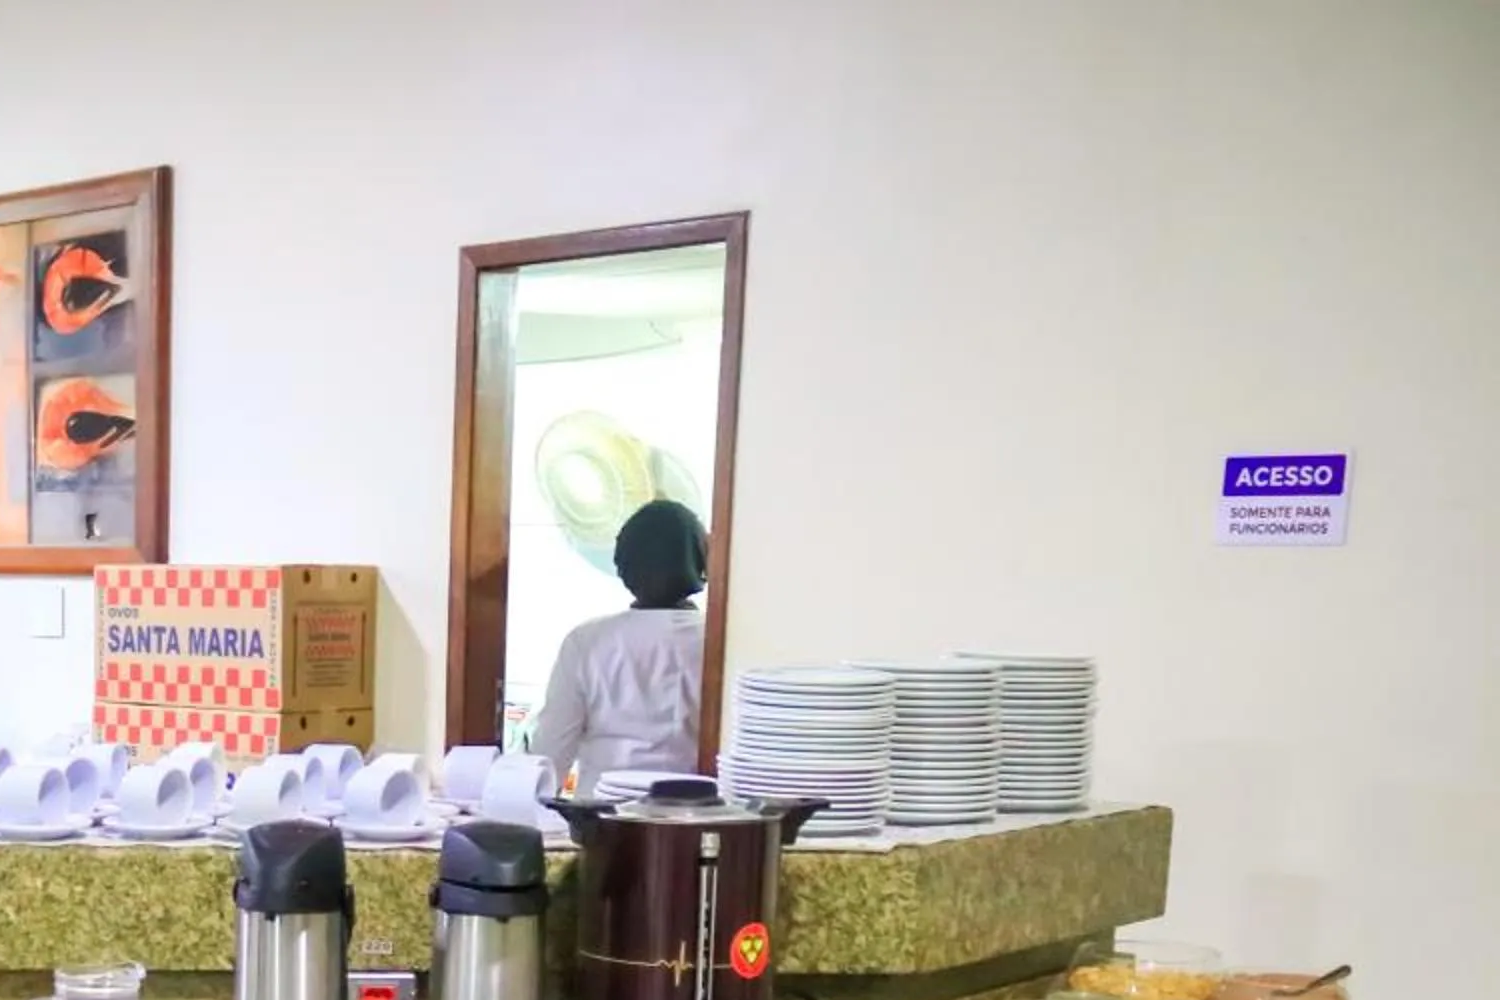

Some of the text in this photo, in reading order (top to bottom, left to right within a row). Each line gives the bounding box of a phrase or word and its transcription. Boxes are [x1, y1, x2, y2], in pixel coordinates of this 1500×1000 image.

[1235, 465, 1333, 487] ACESSO
[1229, 506, 1331, 519] SOMENTE PARA
[108, 607, 139, 618] OVOS
[108, 624, 265, 658] SANTA MARIA
